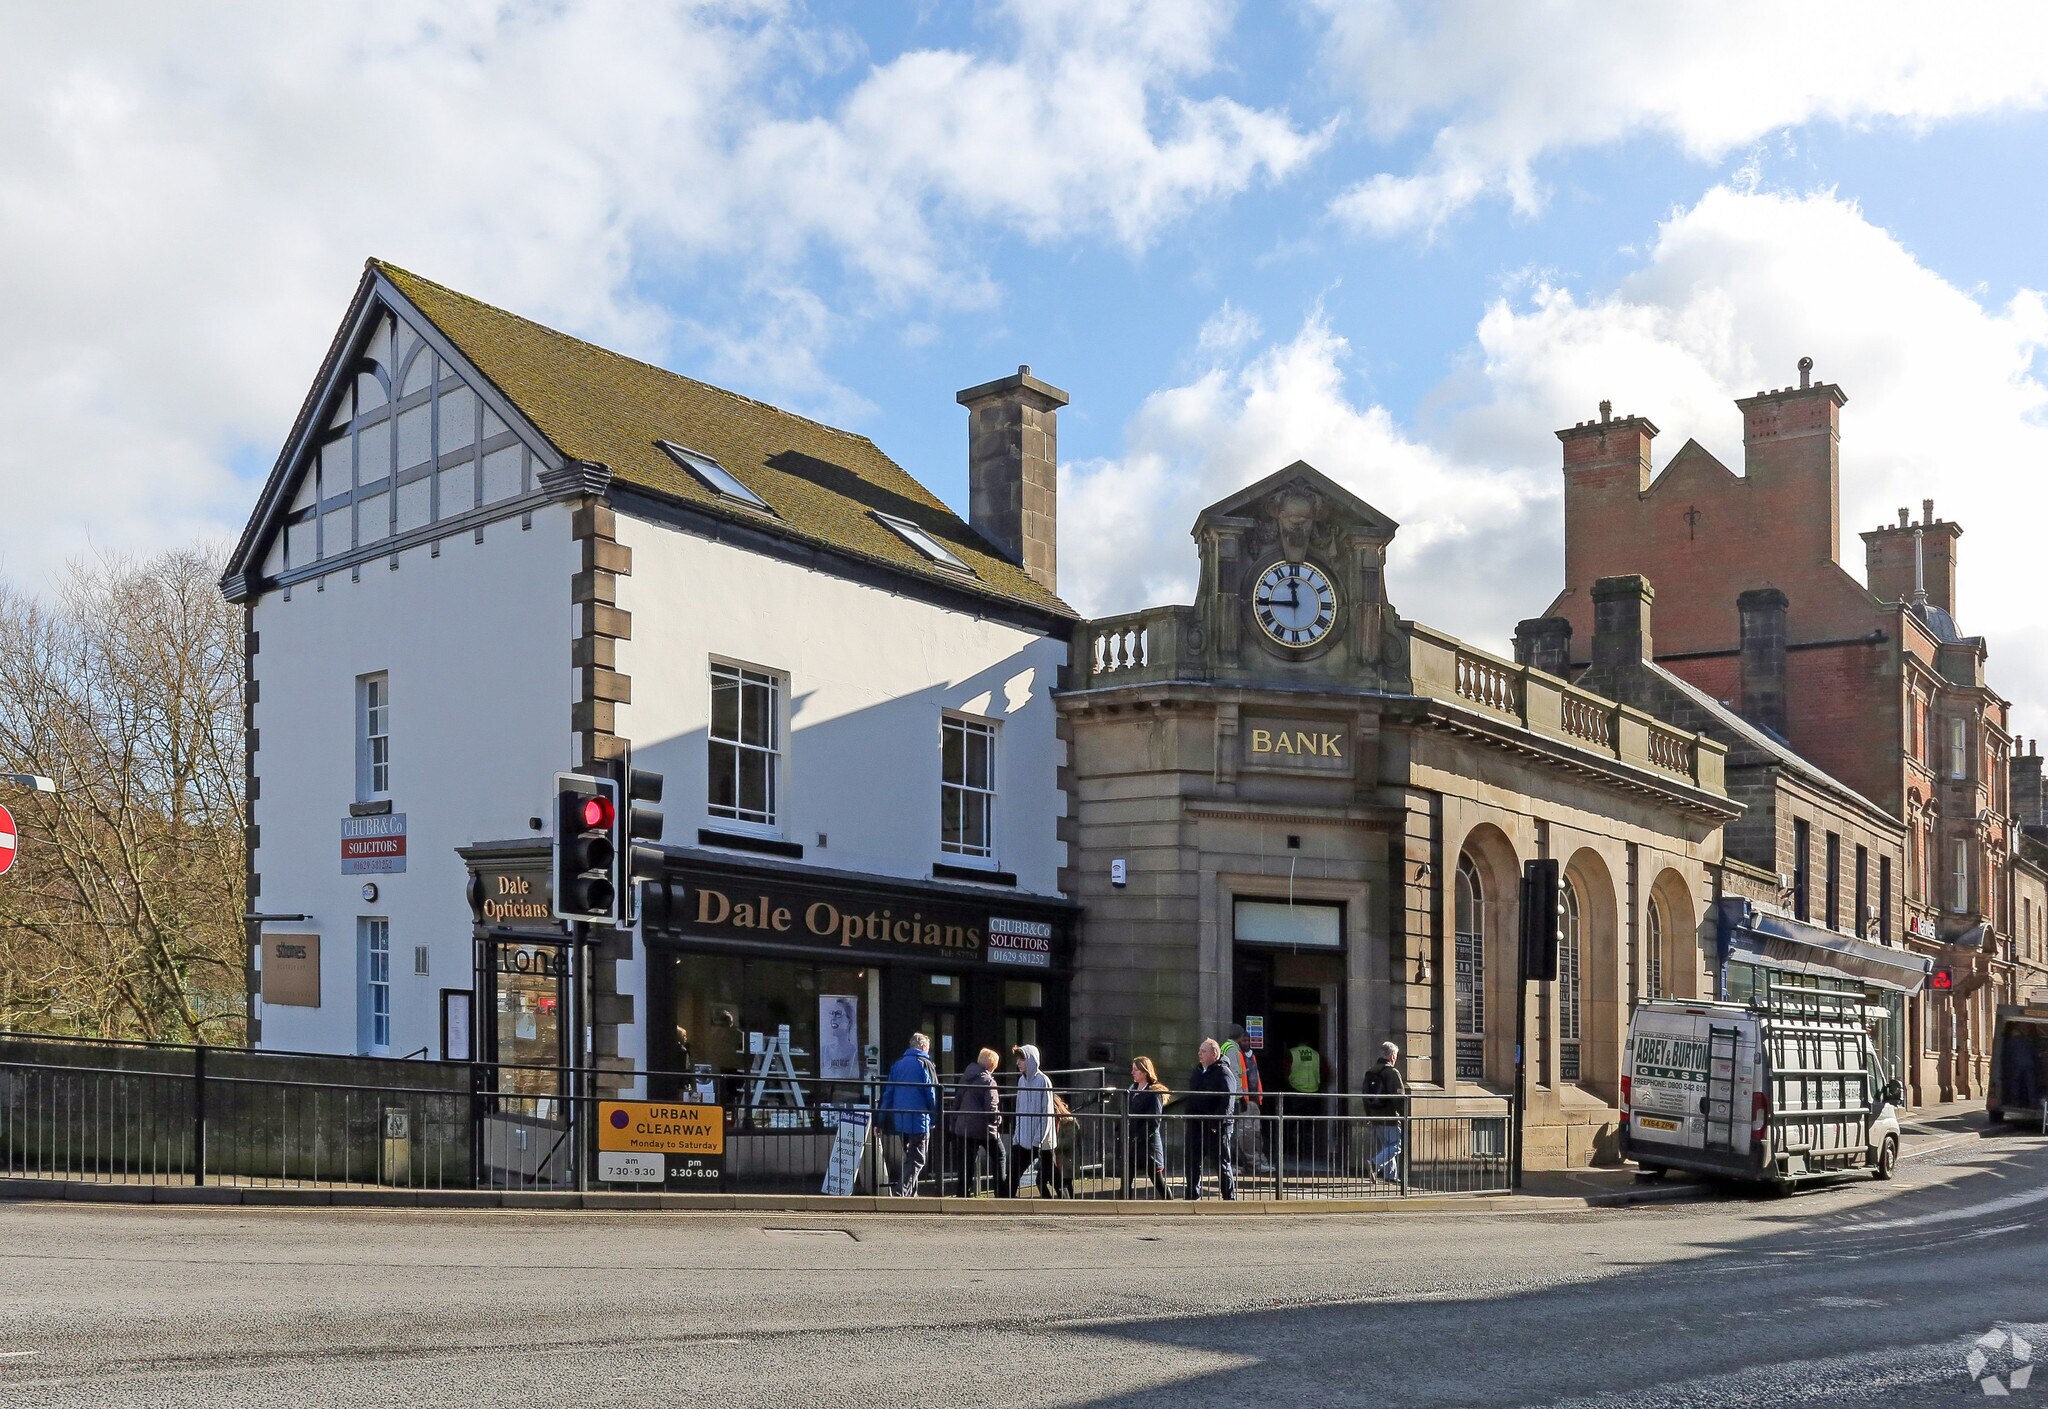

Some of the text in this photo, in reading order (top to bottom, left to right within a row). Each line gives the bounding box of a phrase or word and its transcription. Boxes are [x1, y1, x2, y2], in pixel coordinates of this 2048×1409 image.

[1252, 729, 1342, 757] BANK
[344, 816, 403, 836] CHUBB&Co
[348, 840, 398, 854] SOLICITORS
[498, 876, 529, 894] Dale
[484, 899, 548, 922] Opticians
[694, 888, 980, 949] Dale Opticians
[991, 918, 1050, 936] CHUBB&Co
[990, 933, 1049, 951] SOLICITORS
[500, 942, 568, 974] tone
[993, 950, 1045, 965] 01629 581252
[1636, 1038, 1709, 1070] ABBEY & BURTON
[1640, 1067, 1704, 1081] GLASS
[1634, 1078, 1667, 1088] FREEPHONE:
[1668, 1082, 1682, 1090] 0800
[650, 1108, 699, 1120] URBAN
[637, 1123, 712, 1136] CLEARWAY
[630, 1139, 718, 1150] Monday to Saturday
